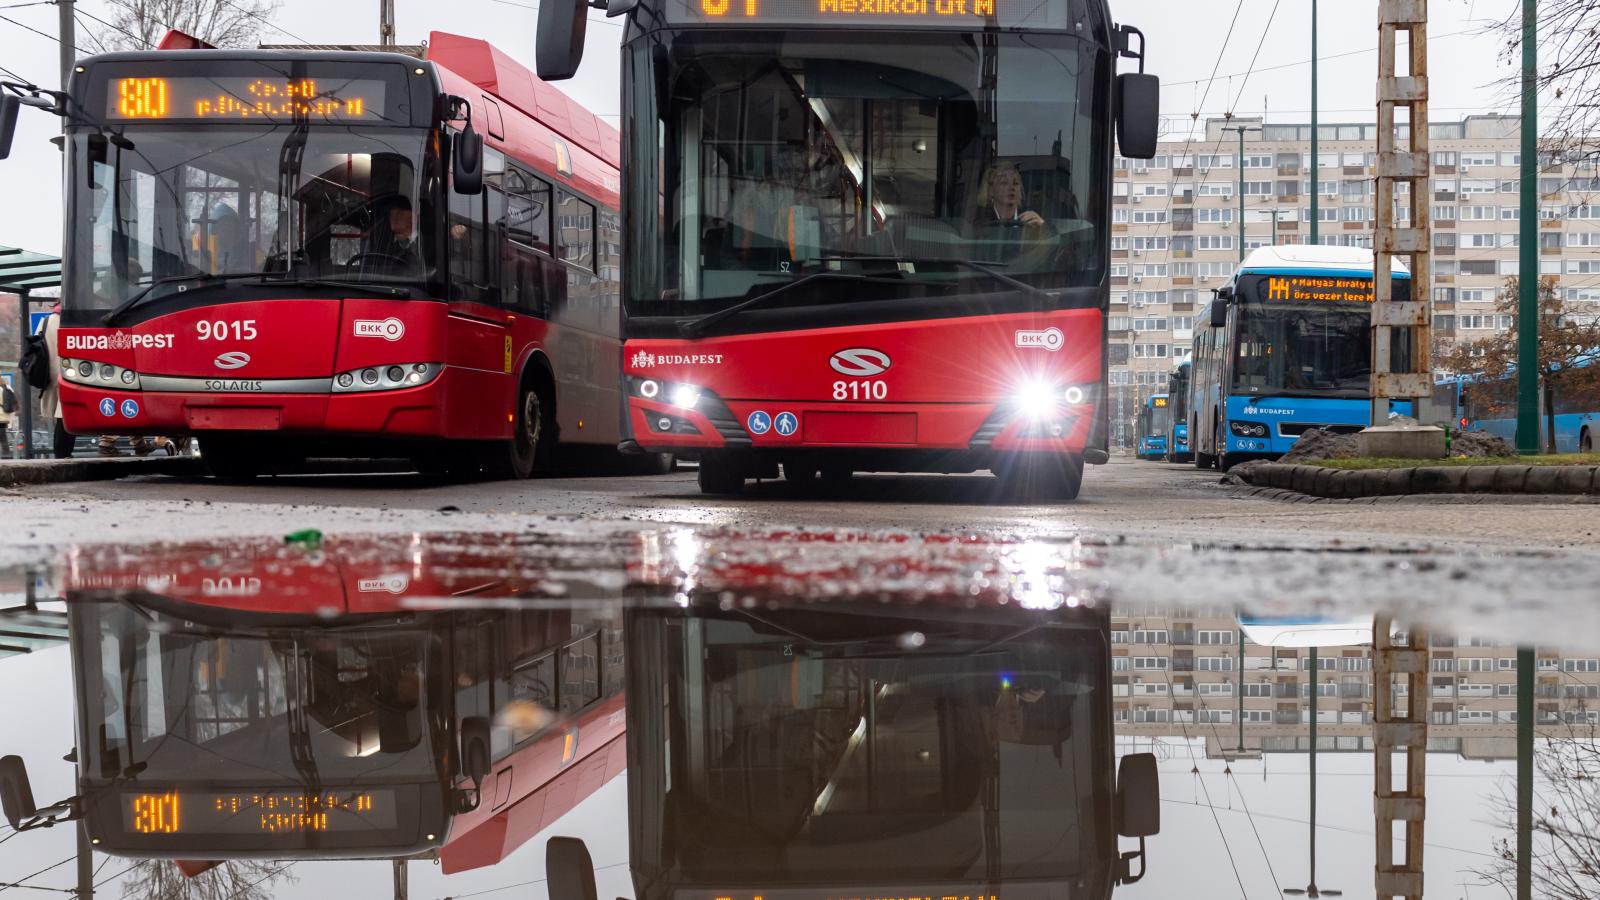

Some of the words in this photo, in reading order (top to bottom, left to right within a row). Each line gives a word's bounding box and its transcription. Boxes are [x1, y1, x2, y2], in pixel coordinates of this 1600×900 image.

[119, 78, 167, 117] 80
[196, 320, 257, 341] 9015
[360, 324, 382, 332] BKK
[1022, 335, 1042, 343] BKK
[657, 354, 723, 365] BUDAPEST
[205, 380, 262, 391] SOLARIS
[832, 380, 888, 400] 8110
